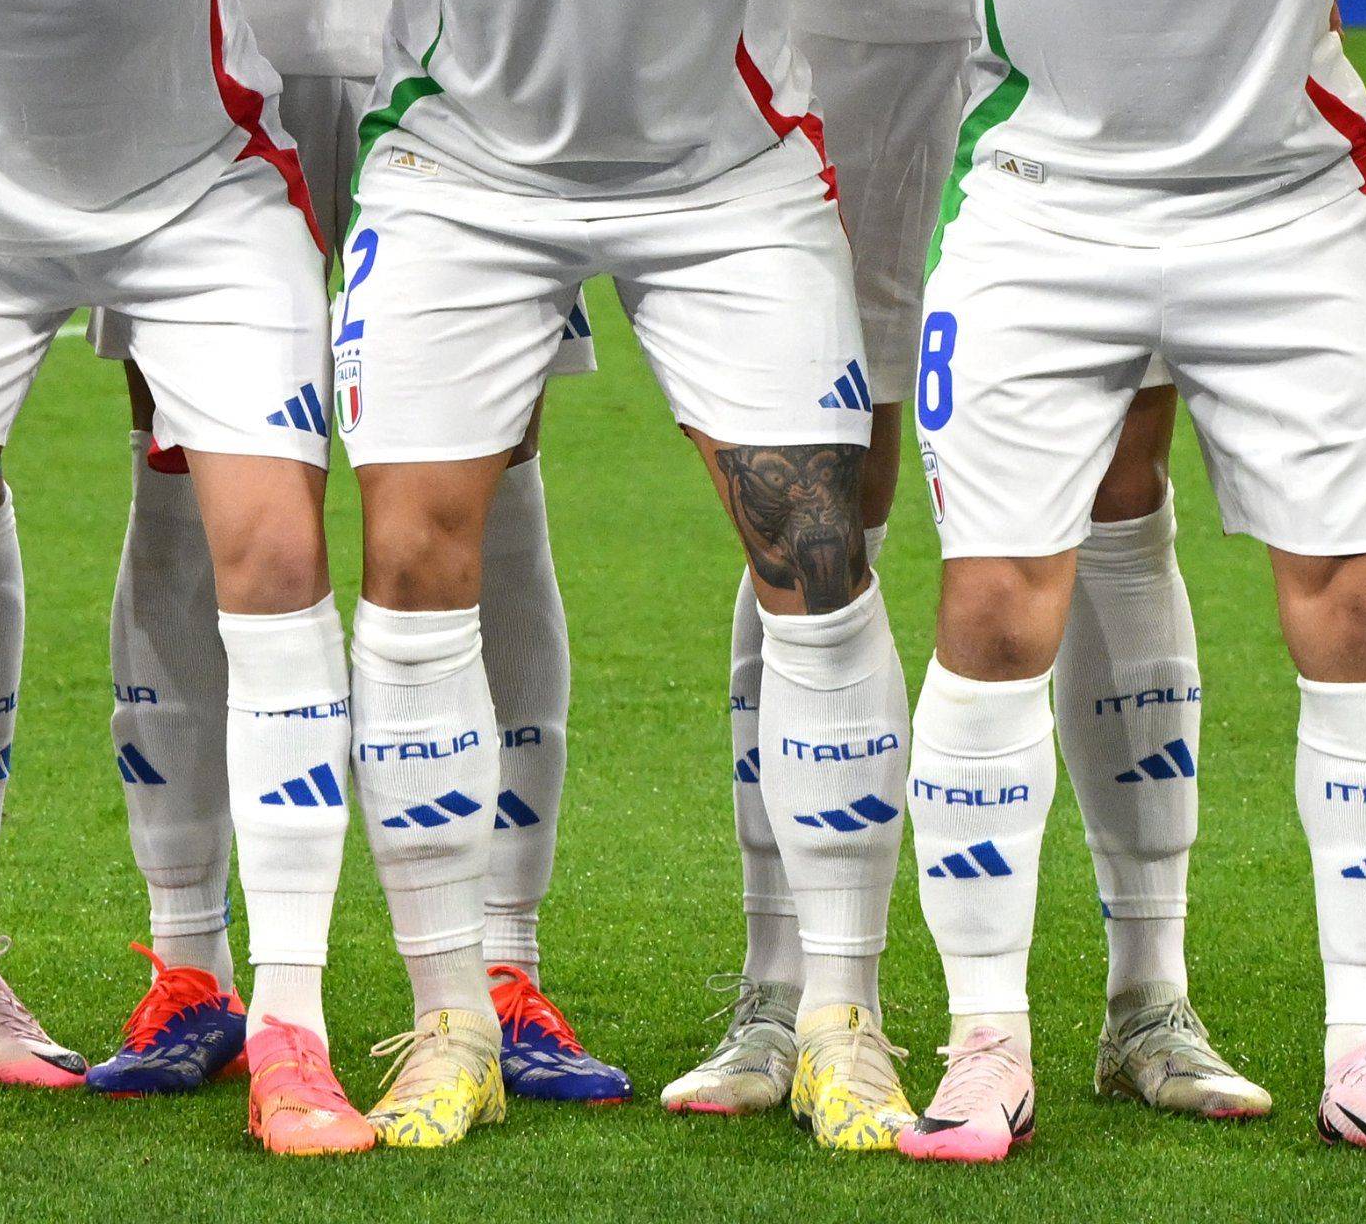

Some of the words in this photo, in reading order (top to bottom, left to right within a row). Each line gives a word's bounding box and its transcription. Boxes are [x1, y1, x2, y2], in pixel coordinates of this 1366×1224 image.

[335, 228, 379, 347] 2
[918, 310, 958, 431] 8
[1095, 687, 1201, 716] ITALIA
[359, 729, 480, 763] ITALIA
[783, 733, 898, 762] ITALIA
[913, 778, 1029, 807] ITALIA
